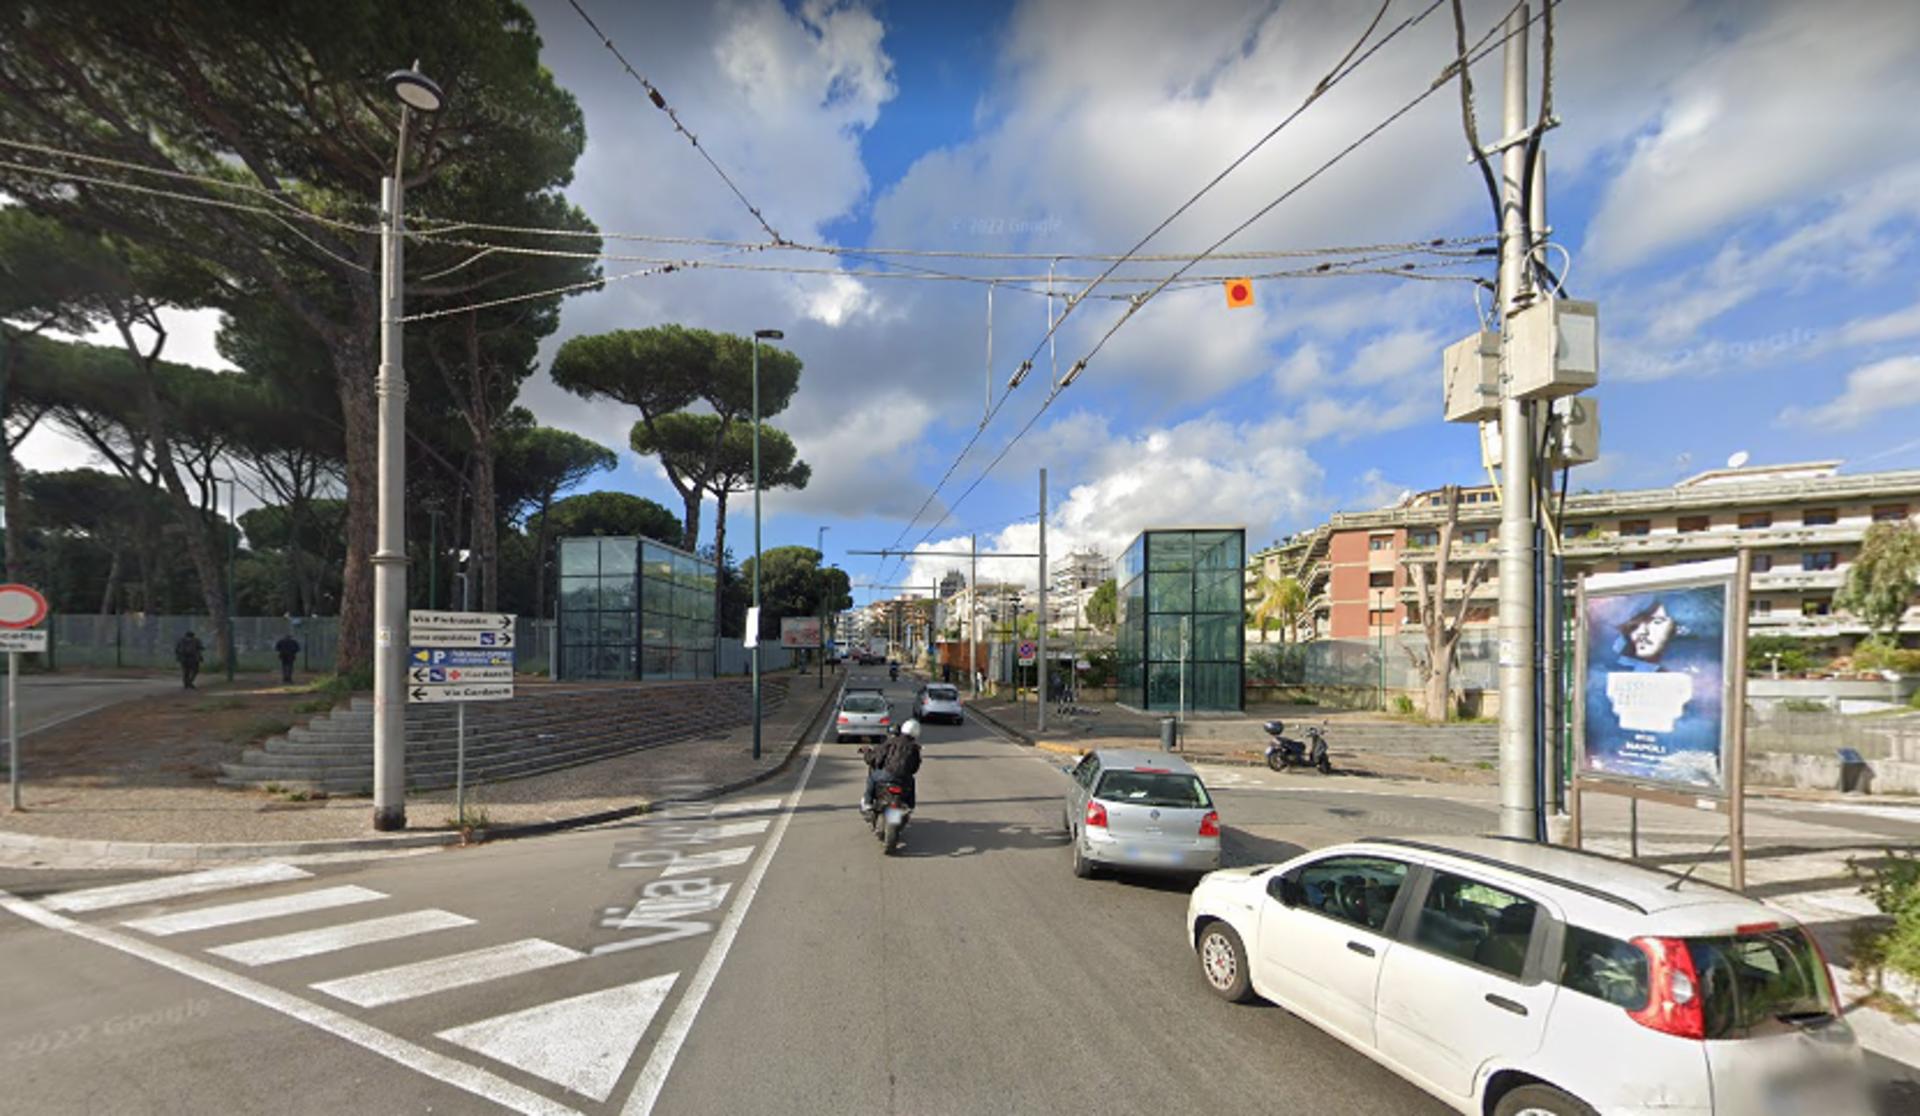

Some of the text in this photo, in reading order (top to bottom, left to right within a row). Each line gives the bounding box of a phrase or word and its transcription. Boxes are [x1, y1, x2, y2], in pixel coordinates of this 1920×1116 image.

[413, 615, 431, 624] Via
[433, 650, 446, 664] P
[443, 689, 461, 697] Via
